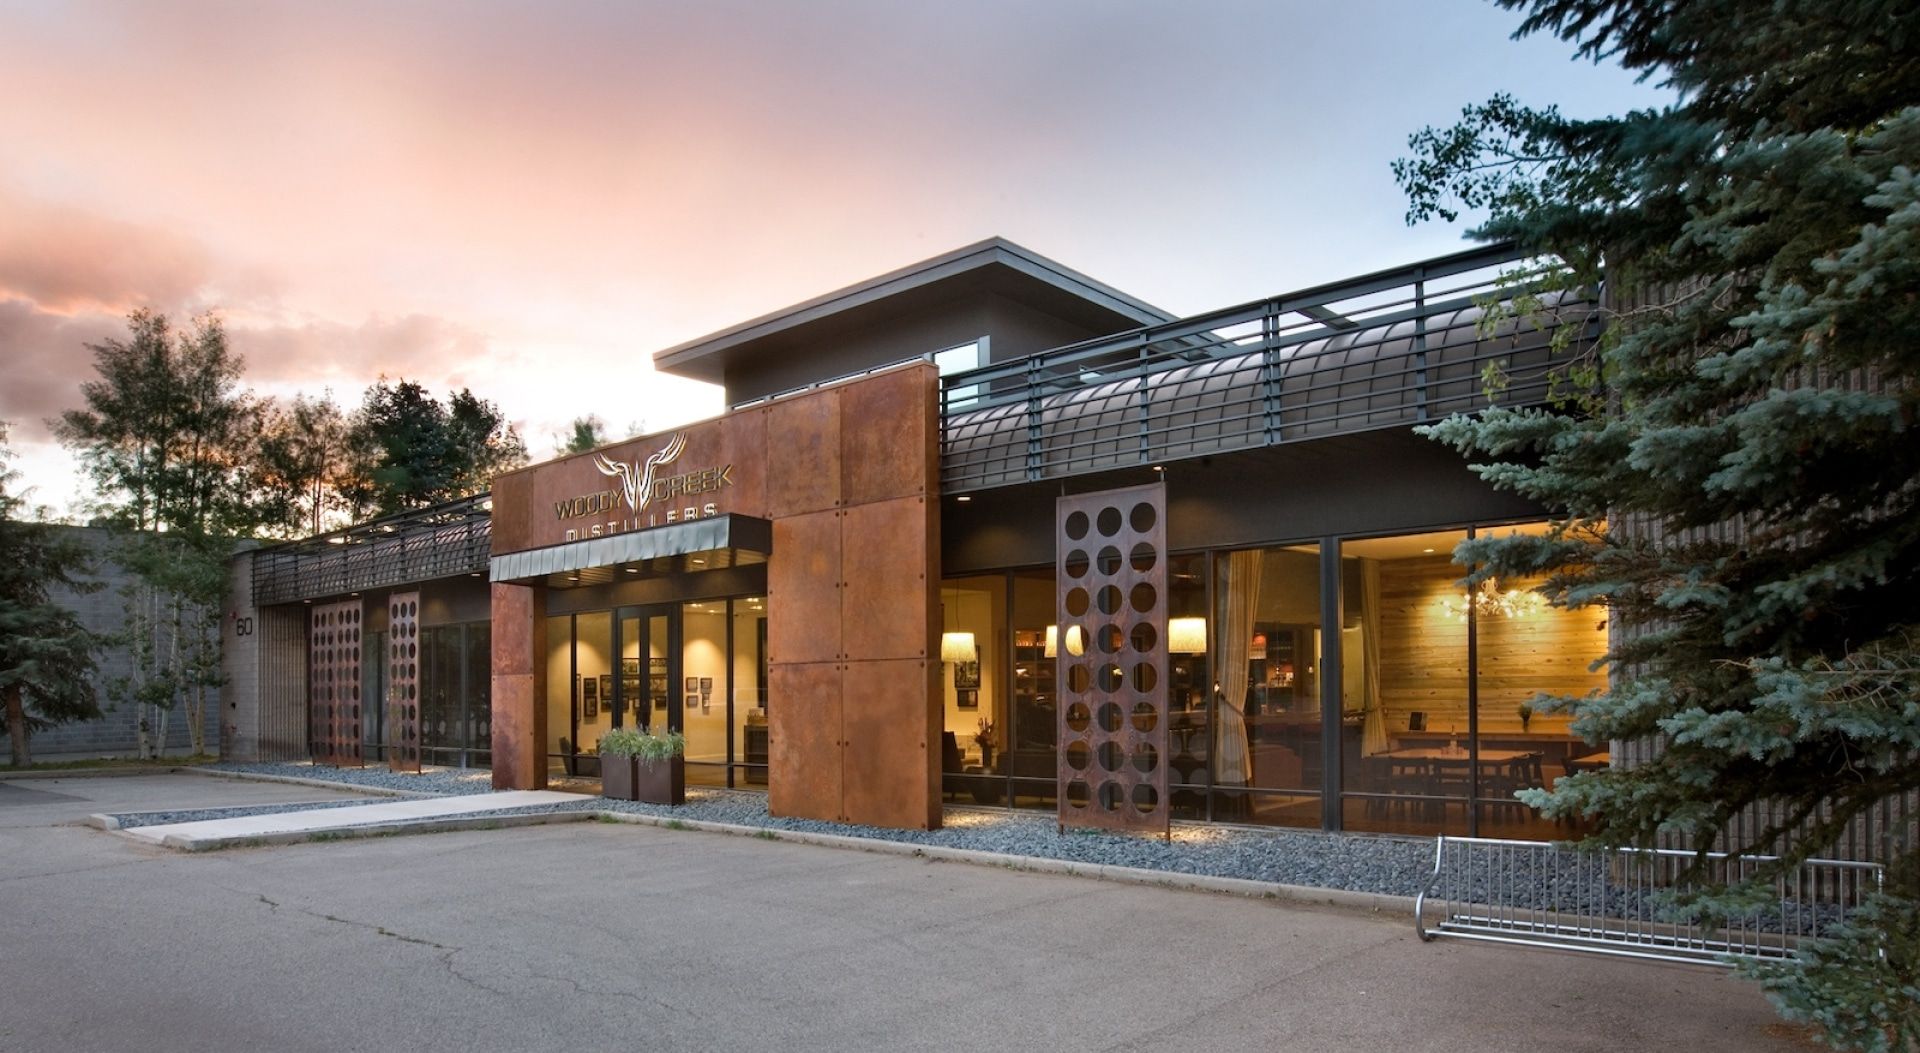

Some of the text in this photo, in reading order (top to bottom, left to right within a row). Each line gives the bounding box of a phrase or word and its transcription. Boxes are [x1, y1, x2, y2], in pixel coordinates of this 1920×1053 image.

[555, 464, 734, 520] WOODY CREEK
[236, 617, 253, 636] 60
